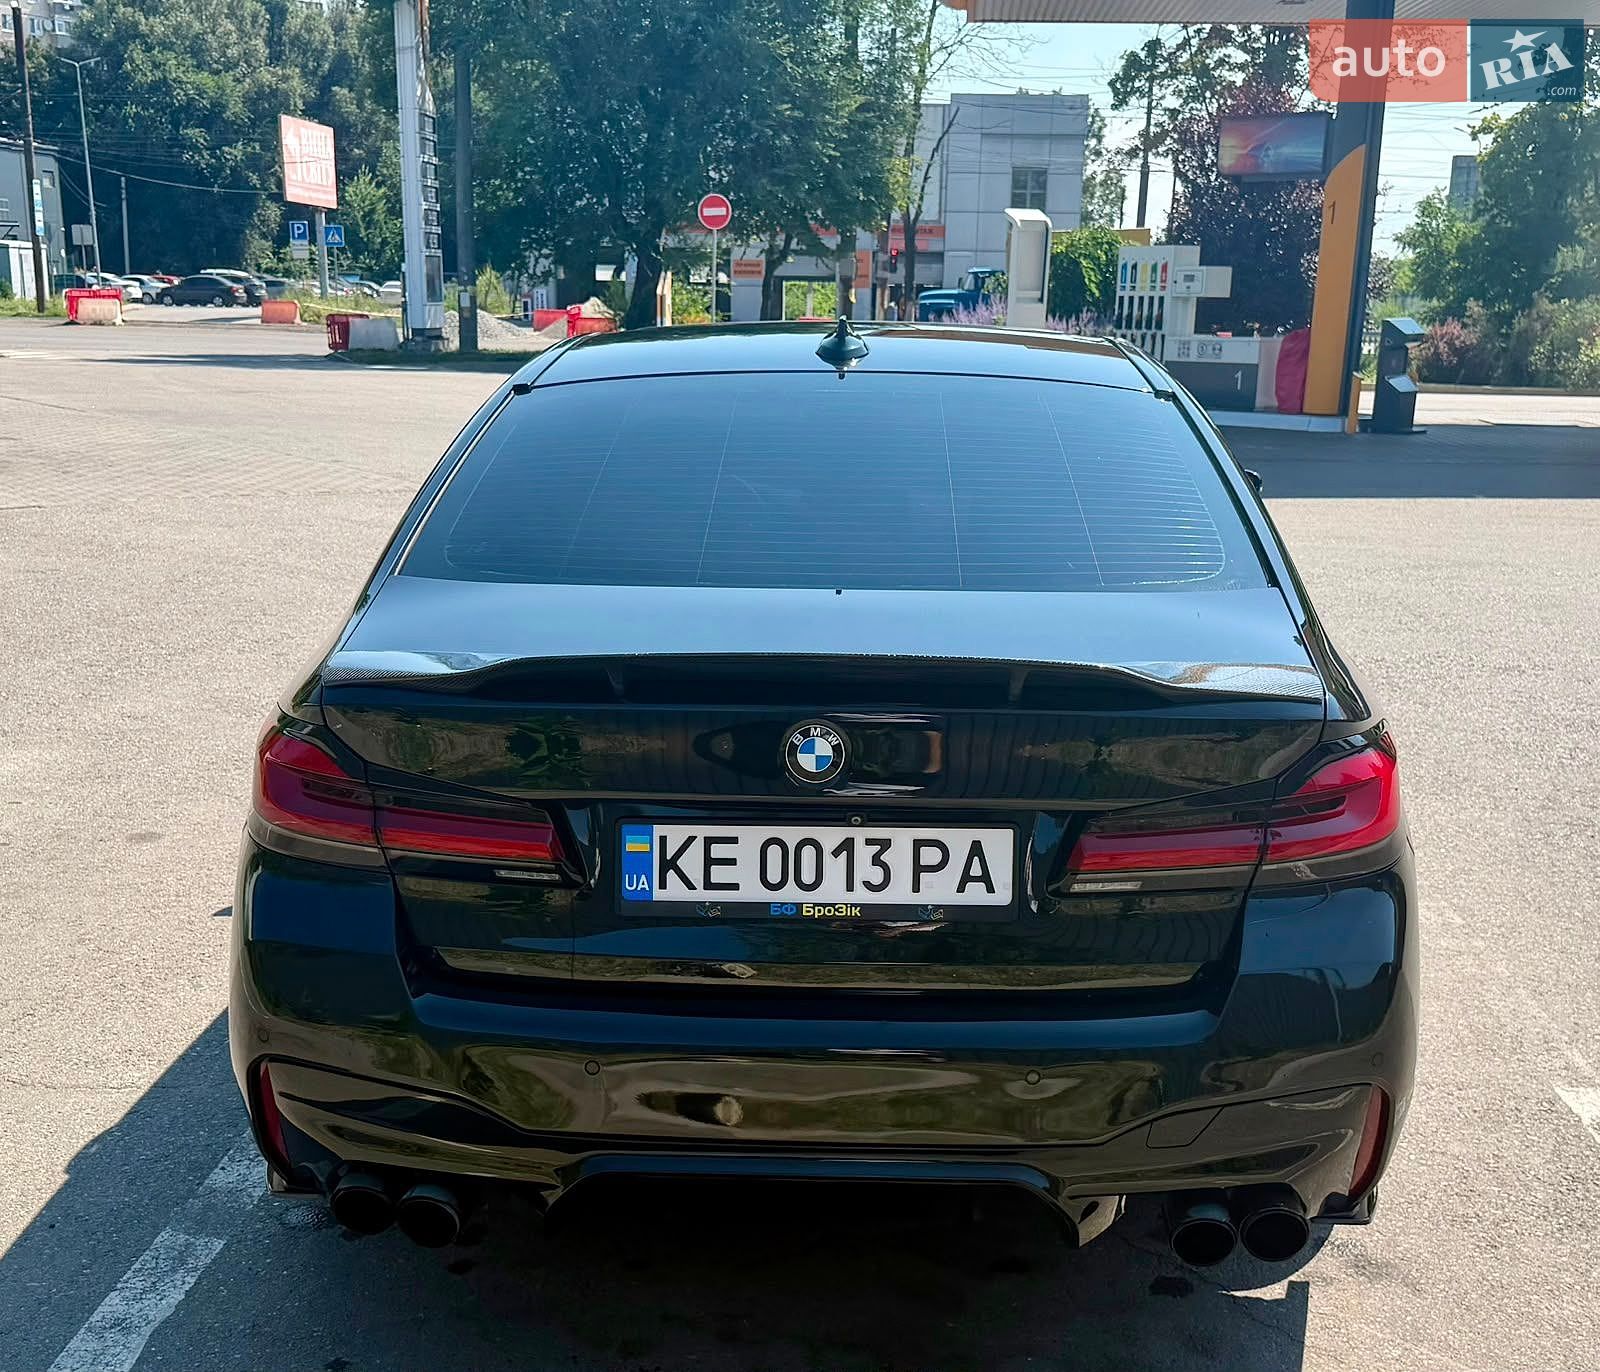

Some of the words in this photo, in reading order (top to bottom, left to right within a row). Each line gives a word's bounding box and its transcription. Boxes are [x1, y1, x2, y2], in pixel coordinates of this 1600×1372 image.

[1327, 200, 1336, 224] 1
[293, 223, 304, 239] P
[1233, 369, 1243, 390] 1
[791, 727, 839, 746] BMW
[658, 835, 740, 891] KE
[759, 837, 892, 893] 0013
[912, 838, 996, 893] PA
[625, 874, 649, 891] UA
[769, 904, 797, 916] БФ
[802, 904, 861, 918] БроЗік
